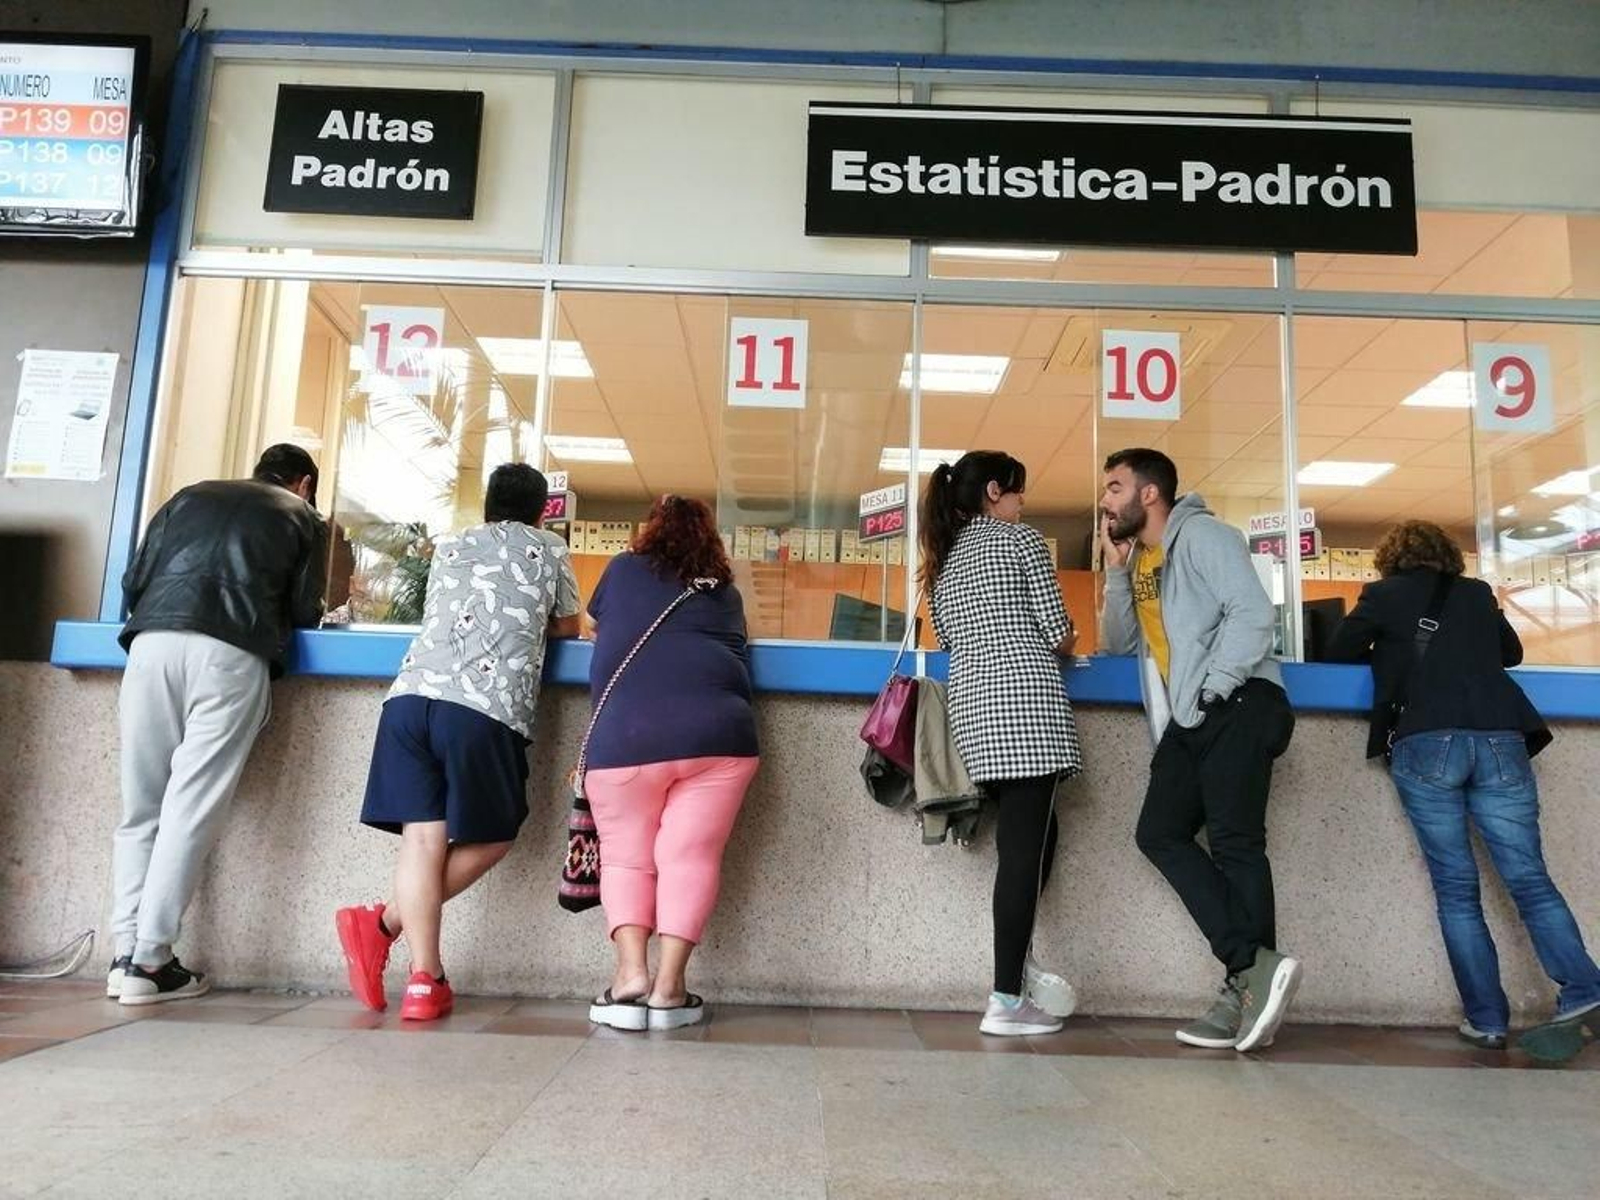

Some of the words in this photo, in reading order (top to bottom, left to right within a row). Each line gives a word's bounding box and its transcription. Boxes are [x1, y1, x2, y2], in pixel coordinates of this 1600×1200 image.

[93, 77, 127, 100] MESA
[0, 107, 71, 132] P139
[89, 110, 124, 134] 09
[317, 109, 434, 143] Altas
[0, 140, 68, 163] P138
[87, 143, 122, 165] 09
[291, 154, 450, 191] Padrón
[830, 150, 1393, 208] Estatística-Padrón
[735, 335, 801, 391] 11
[1106, 346, 1177, 402] 10
[1490, 356, 1535, 419] 9
[552, 475, 566, 488] 12
[861, 491, 888, 510] MESA
[891, 488, 904, 502] 11
[866, 510, 903, 535] P125
[1258, 535, 1312, 555] P15
